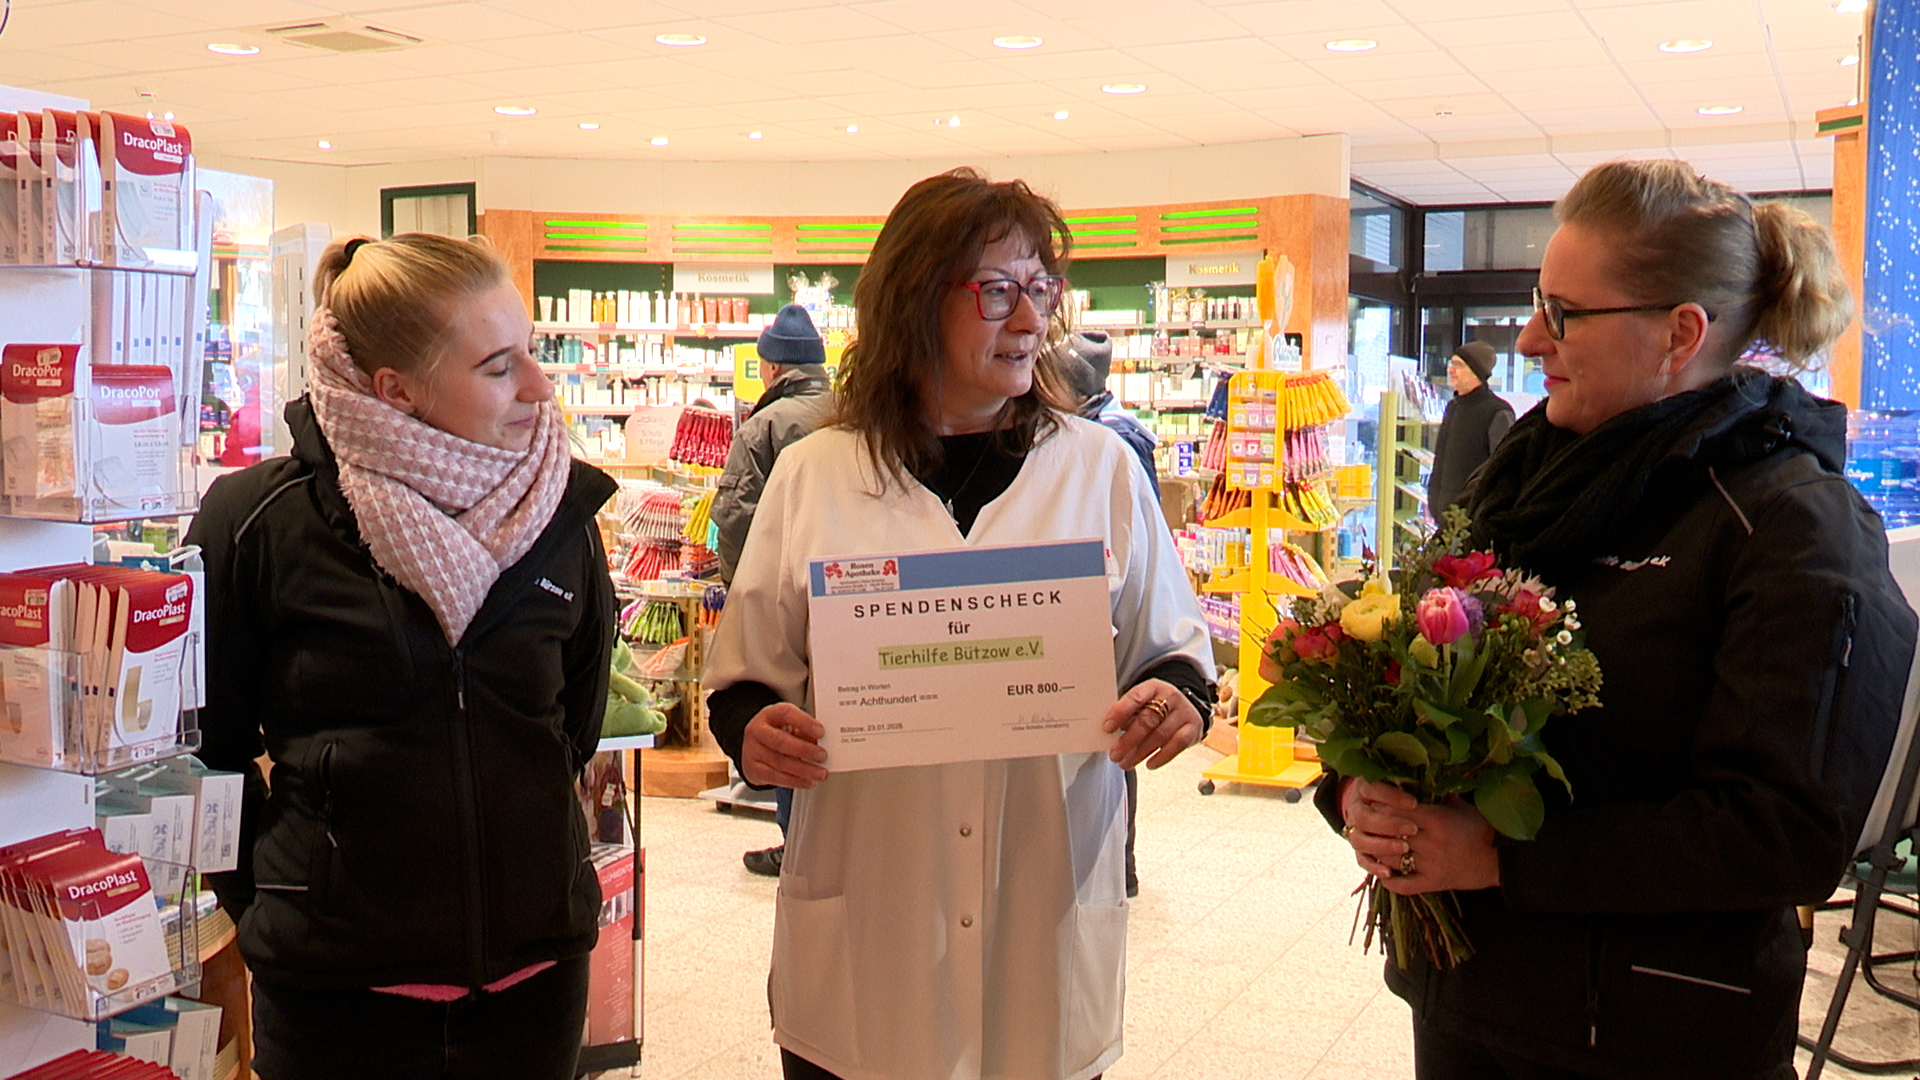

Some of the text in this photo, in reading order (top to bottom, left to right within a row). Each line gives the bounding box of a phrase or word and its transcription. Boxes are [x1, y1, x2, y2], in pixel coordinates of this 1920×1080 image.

[124, 132, 183, 155] DracoPlast
[1188, 262, 1240, 275] Kosmetik
[698, 272, 750, 283] Kosmetik
[13, 363, 63, 377] DracoPor
[100, 385, 161, 399] DracoPor
[850, 562, 874, 570] Rosen
[845, 569, 880, 578] Apotheke
[854, 590, 1062, 618] SPENDENSCHECK
[133, 601, 186, 623] DracoPlast
[948, 621, 970, 635] für
[879, 641, 1044, 666] Tierhilfe Bützow e.V.
[838, 685, 859, 693] Betrag
[1007, 683, 1034, 696] EUR
[859, 694, 918, 706] Achthundert
[68, 870, 138, 899] DracoPlast
